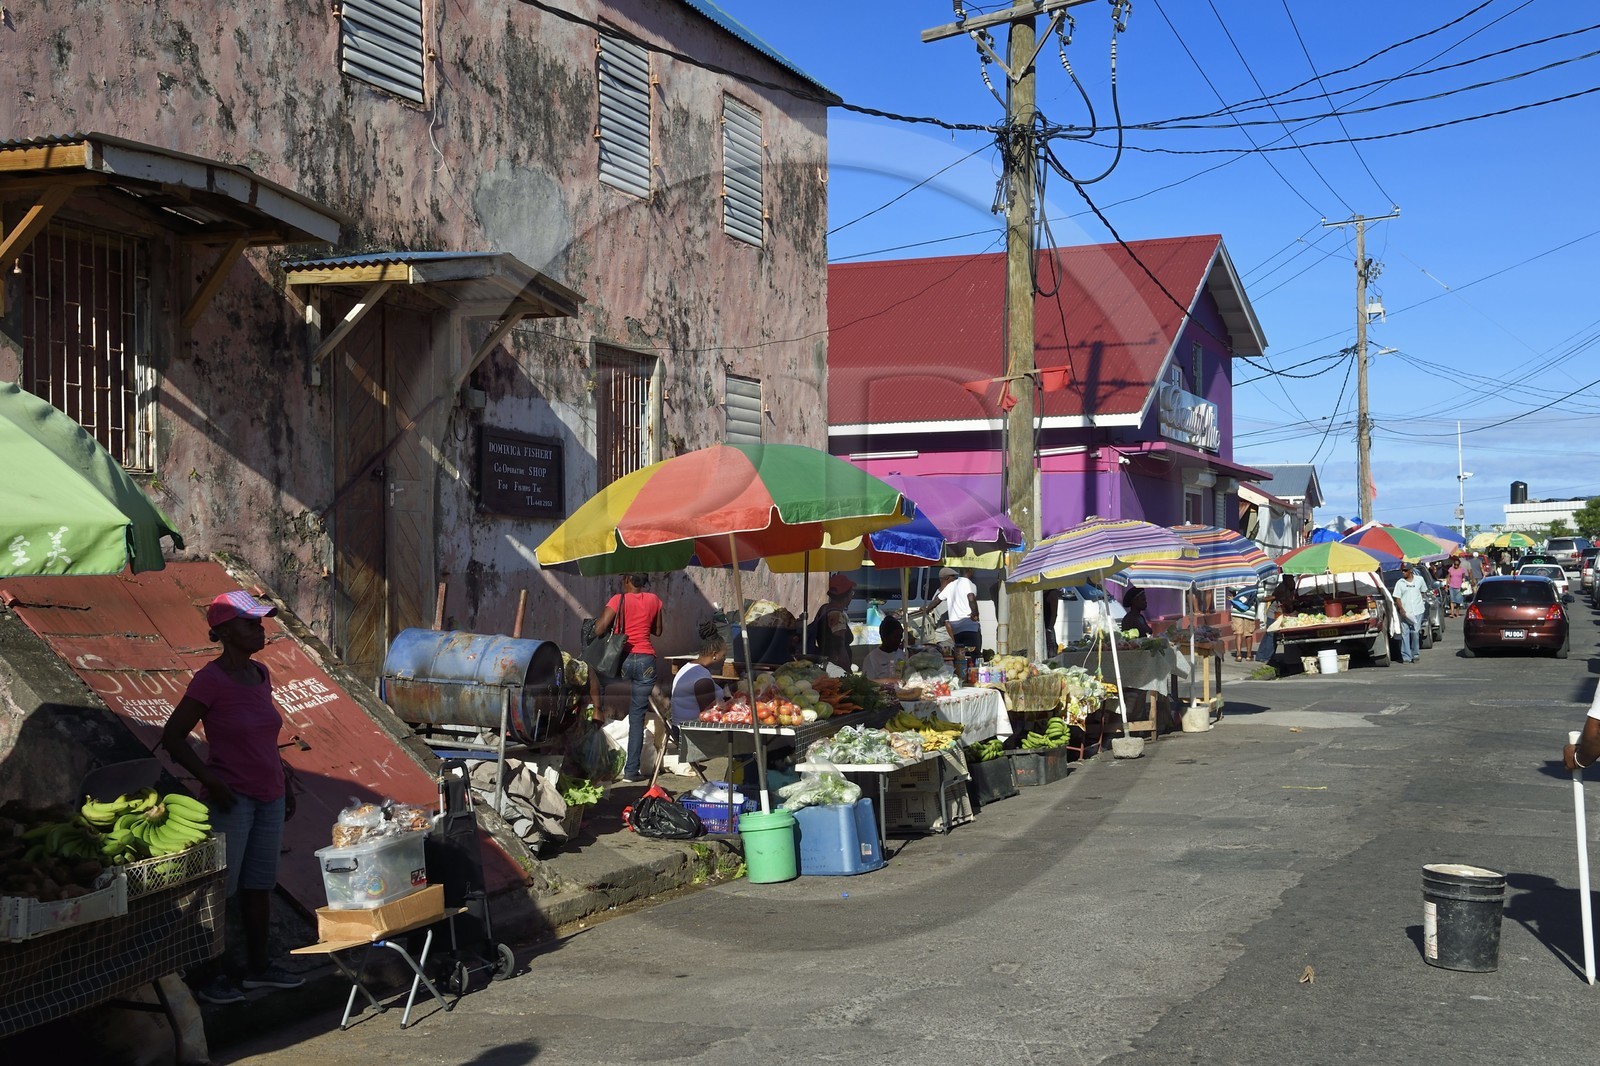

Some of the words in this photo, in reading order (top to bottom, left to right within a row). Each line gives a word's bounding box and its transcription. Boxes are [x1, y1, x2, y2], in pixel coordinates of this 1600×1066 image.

[488, 442, 521, 456] DOMINICA
[528, 466, 547, 478] SHOP
[116, 695, 170, 707] CLEARANCE
[273, 687, 312, 705] SALE
[123, 705, 162, 717] SALE
